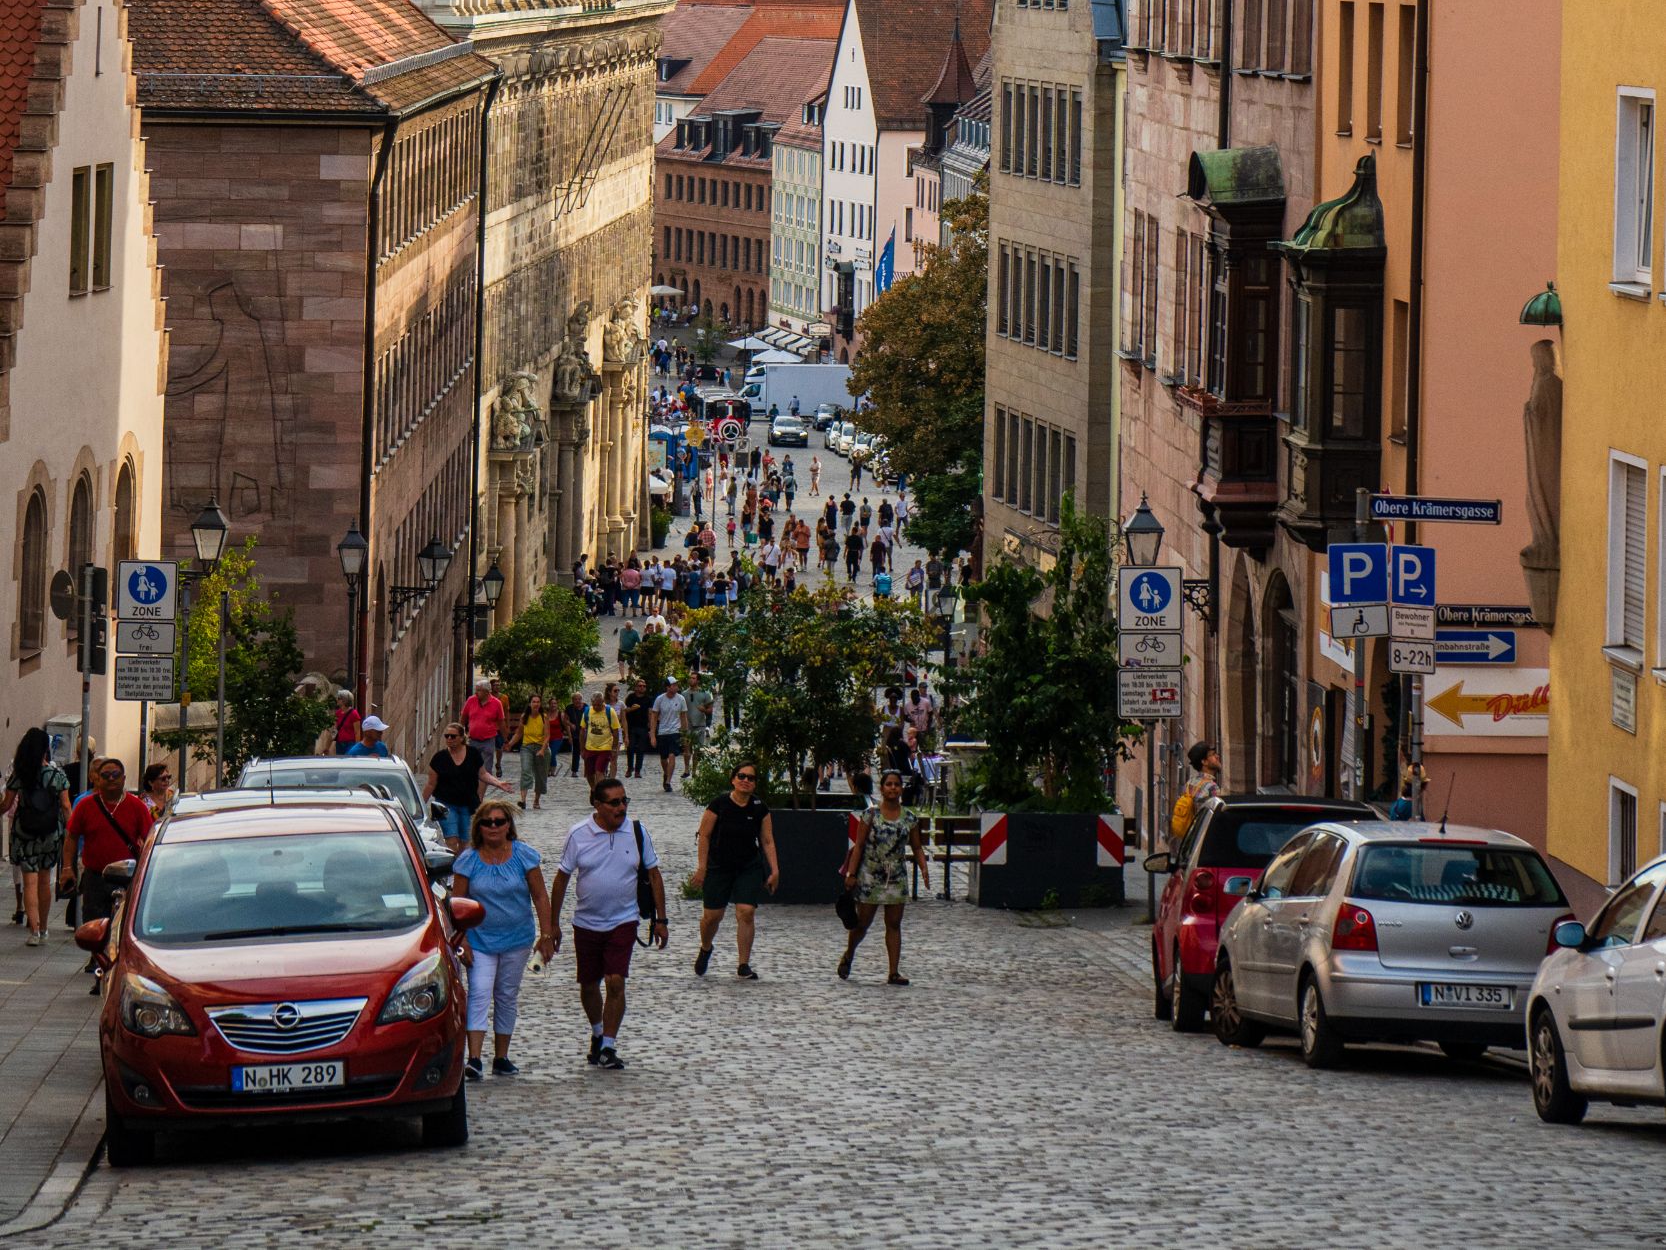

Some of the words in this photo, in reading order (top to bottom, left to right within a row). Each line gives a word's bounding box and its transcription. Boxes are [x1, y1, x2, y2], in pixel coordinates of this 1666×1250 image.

[1375, 500, 1409, 515] Obere
[1412, 501, 1495, 519] Krämersgasse
[1342, 552, 1374, 596] P
[1399, 553, 1422, 597] P
[132, 606, 161, 617] ZONE
[1395, 610, 1430, 621] Bewohner
[1438, 606, 1469, 621] Obere
[1135, 616, 1166, 627] ZONE
[1436, 642, 1490, 651] inbahnstraße
[1143, 656, 1158, 664] frei
[1393, 648, 1432, 667] 8-22h
[1121, 690, 1146, 698] samstags
[1435, 985, 1444, 1001] N
[1454, 987, 1471, 1001] VI
[1475, 988, 1502, 1003] 335
[245, 1069, 257, 1088] N
[269, 1067, 293, 1086] HK
[301, 1064, 337, 1085] 289
